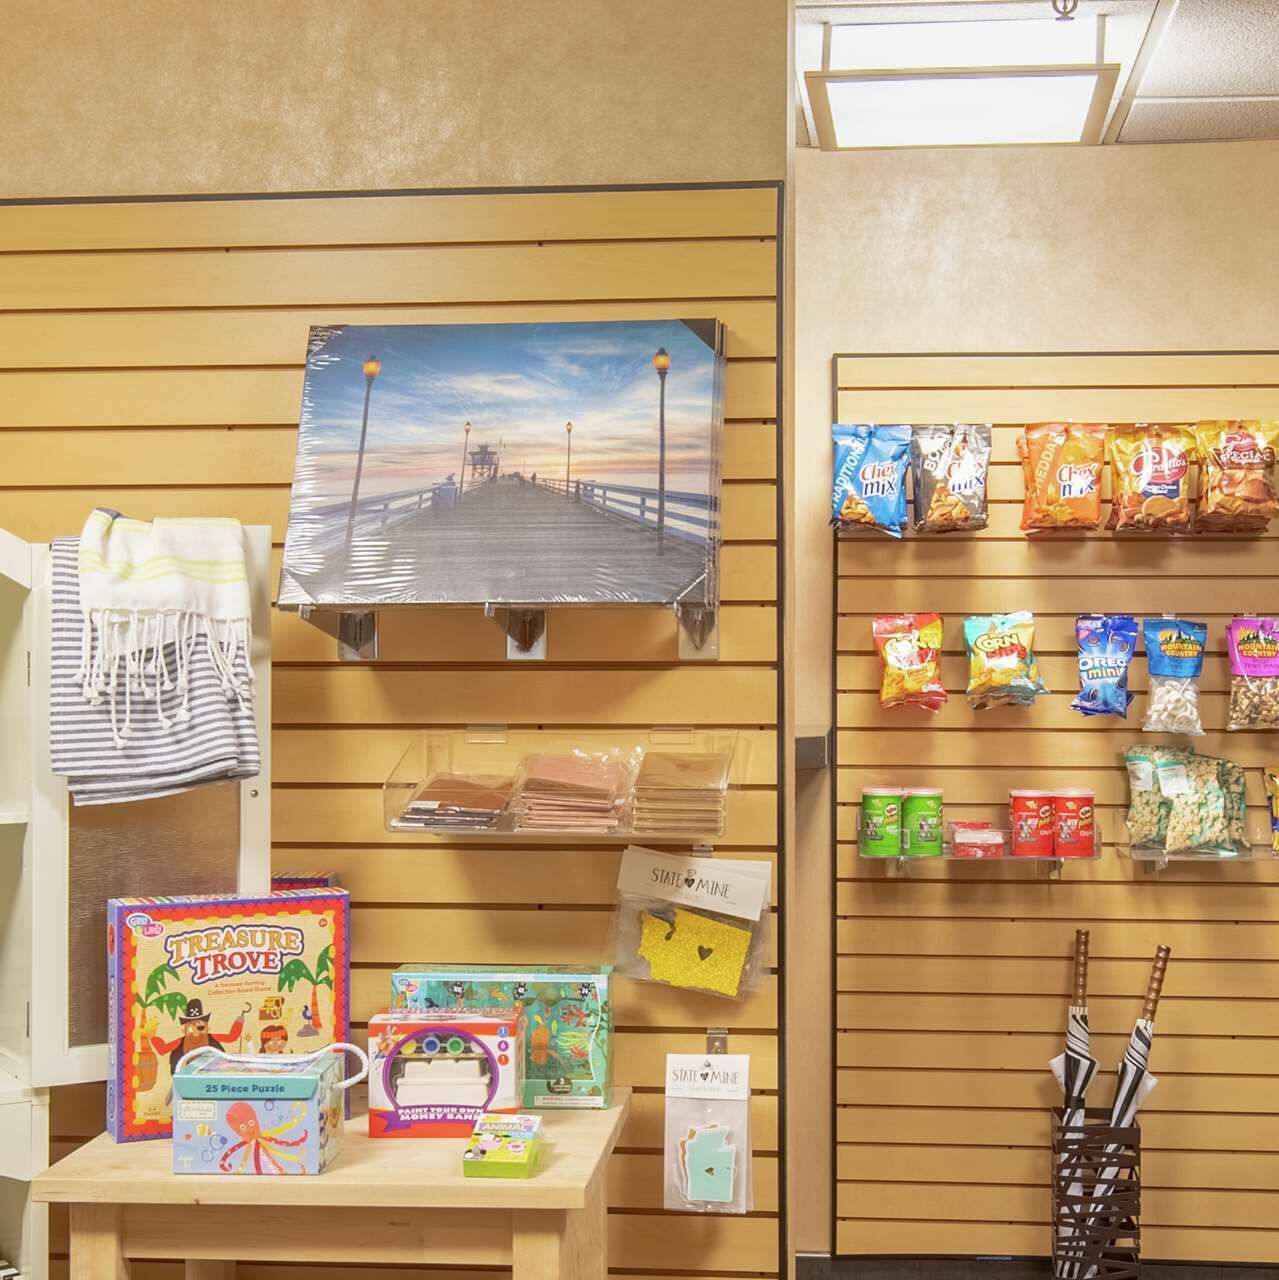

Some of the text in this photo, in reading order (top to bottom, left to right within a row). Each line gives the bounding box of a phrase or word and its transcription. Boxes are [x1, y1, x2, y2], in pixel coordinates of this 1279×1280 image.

[860, 461, 897, 481] Chex
[863, 478, 897, 497] mix
[975, 632, 1021, 653] CORN
[1160, 643, 1202, 651] MOUNTAIN
[1079, 656, 1126, 670] OREO
[650, 868, 683, 889] STATE
[696, 878, 734, 899] MINE
[169, 927, 301, 965] TREASURE
[195, 951, 279, 980] TROVE
[672, 1069, 739, 1084] STATE MINE
[205, 1084, 285, 1093] 25 Piece Puzzle
[400, 1113, 444, 1121] MONEY
[482, 1122, 526, 1131] ANIMAL
